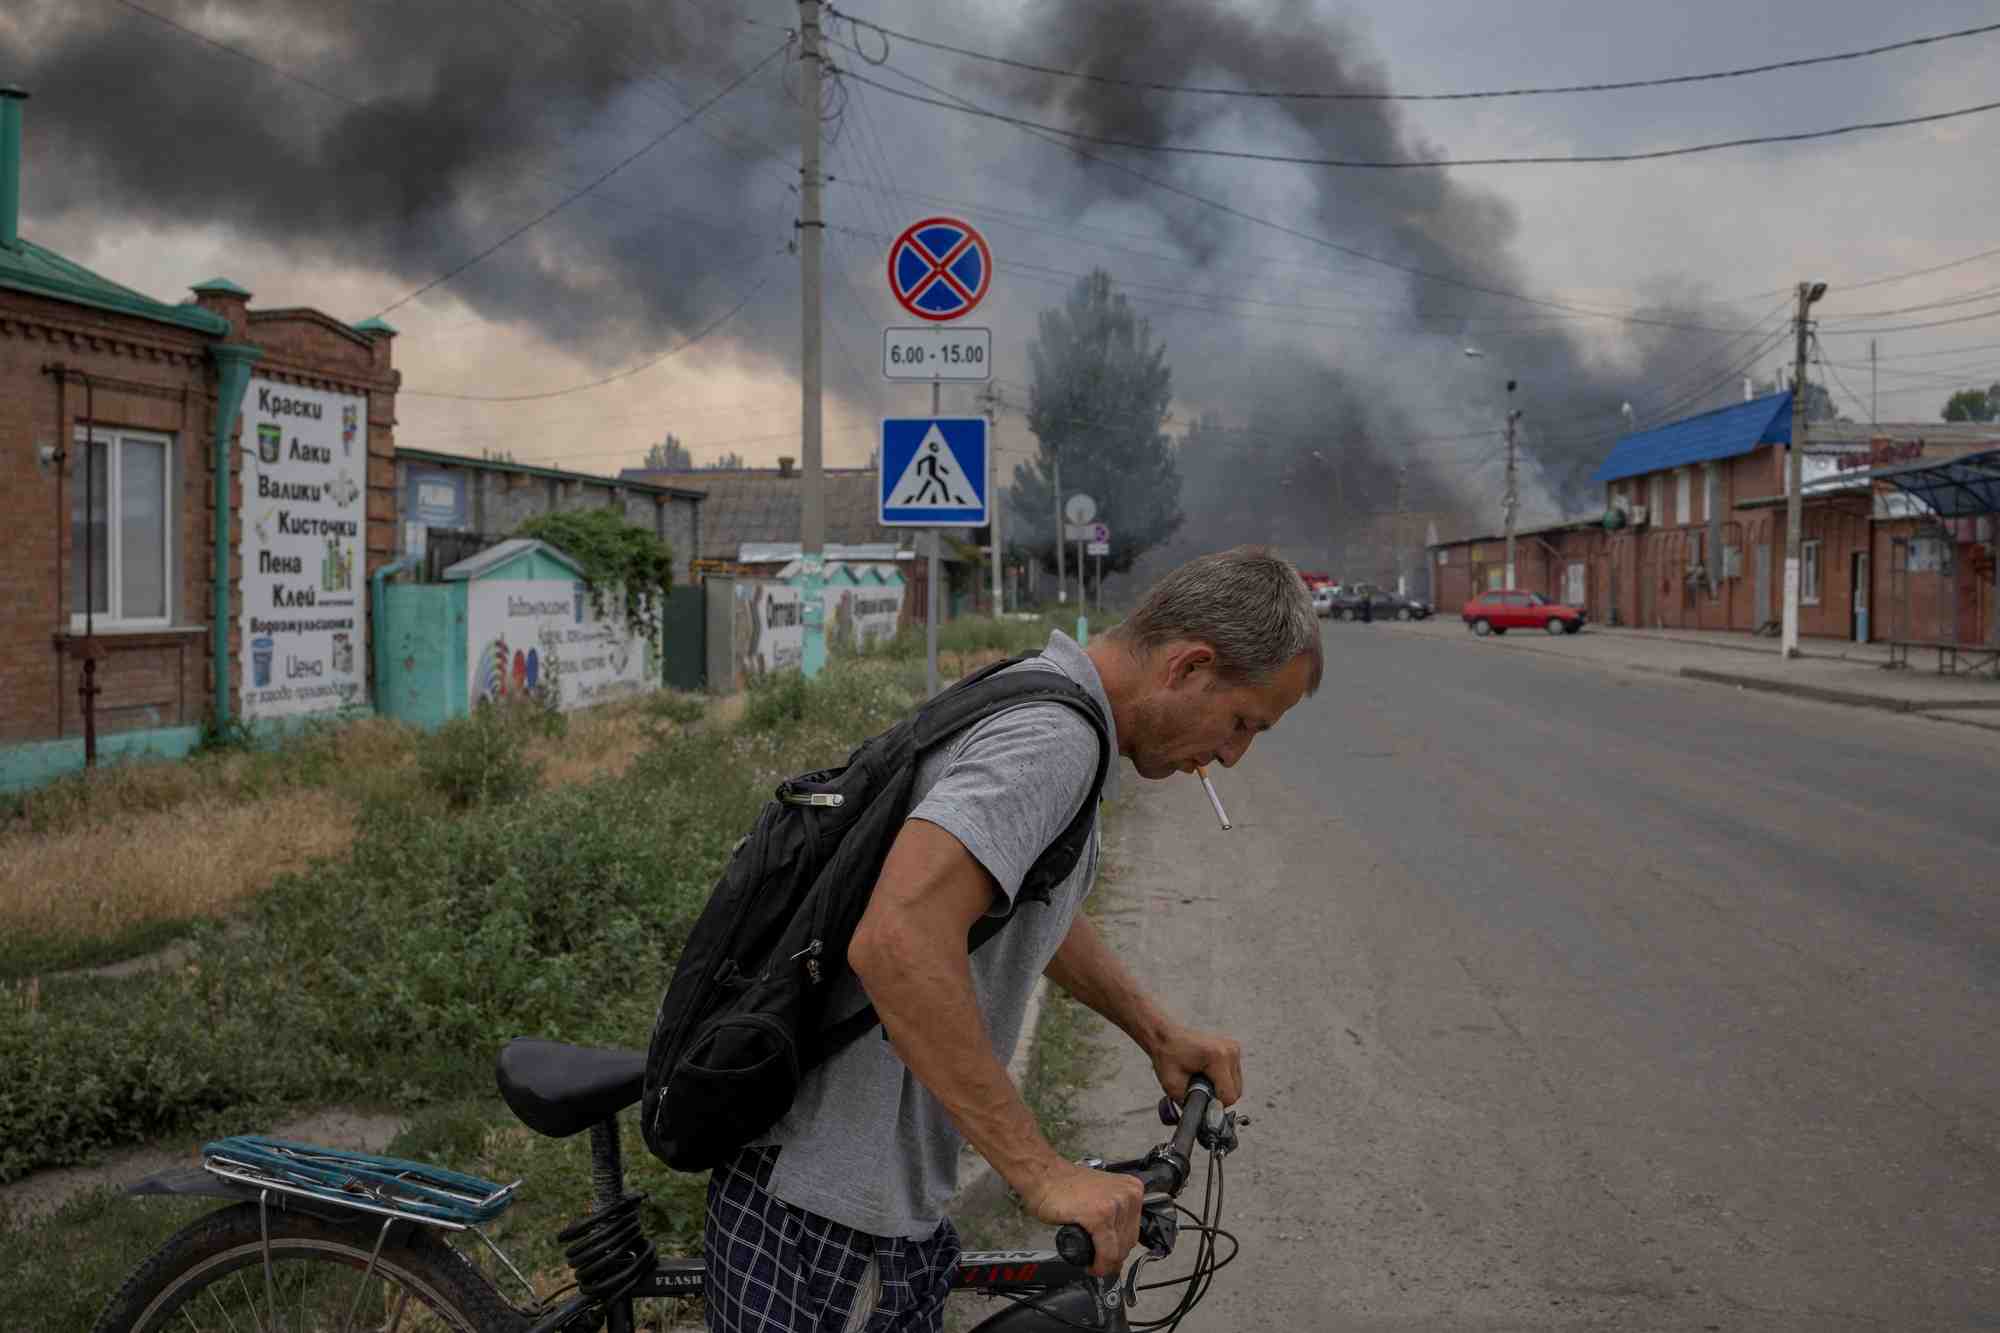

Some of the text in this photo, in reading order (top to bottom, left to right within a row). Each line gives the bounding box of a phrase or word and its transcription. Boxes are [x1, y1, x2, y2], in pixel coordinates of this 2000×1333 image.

[891, 345, 925, 363] 6.00
[941, 344, 984, 363] 15.00
[258, 388, 323, 420] Краски
[289, 437, 331, 464] Лаки
[258, 475, 321, 501] Валики
[278, 511, 357, 537] Кисточки
[259, 549, 302, 575] Пена
[272, 584, 316, 608] Клей
[286, 653, 323, 679] Цена
[655, 1275, 703, 1287] FLASH
